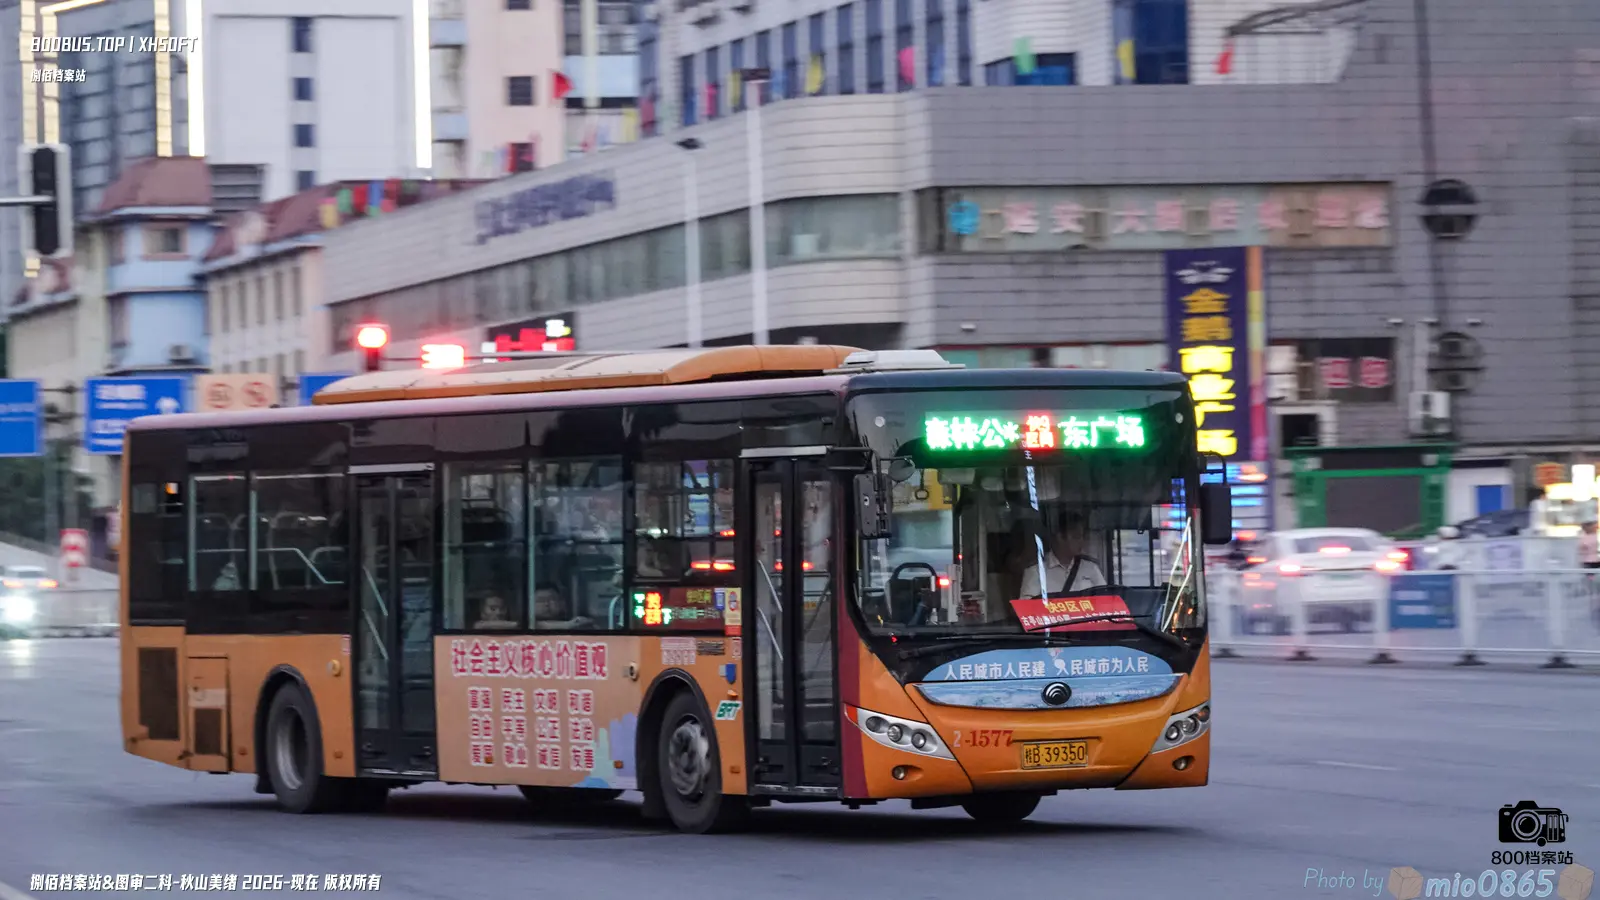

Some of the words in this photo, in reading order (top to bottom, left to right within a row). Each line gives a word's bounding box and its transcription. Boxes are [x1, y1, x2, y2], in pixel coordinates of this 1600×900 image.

[1057, 415, 1146, 449] 东广场
[1046, 600, 1094, 613] 快9区间
[451, 639, 608, 680] 社会主义核心价值观
[944, 660, 1046, 681] 人民城市人民建
[468, 686, 493, 712] 富强
[501, 687, 526, 713] 民主
[534, 688, 560, 714] 文明
[568, 689, 594, 715] 和谐
[716, 702, 741, 719] BRT
[469, 714, 494, 740] 自由
[501, 715, 527, 741] 平等
[535, 716, 561, 742] 公正
[568, 717, 595, 743] 法治
[502, 742, 529, 768] 敬业
[536, 744, 561, 769] 诚信
[569, 745, 595, 771] 友善
